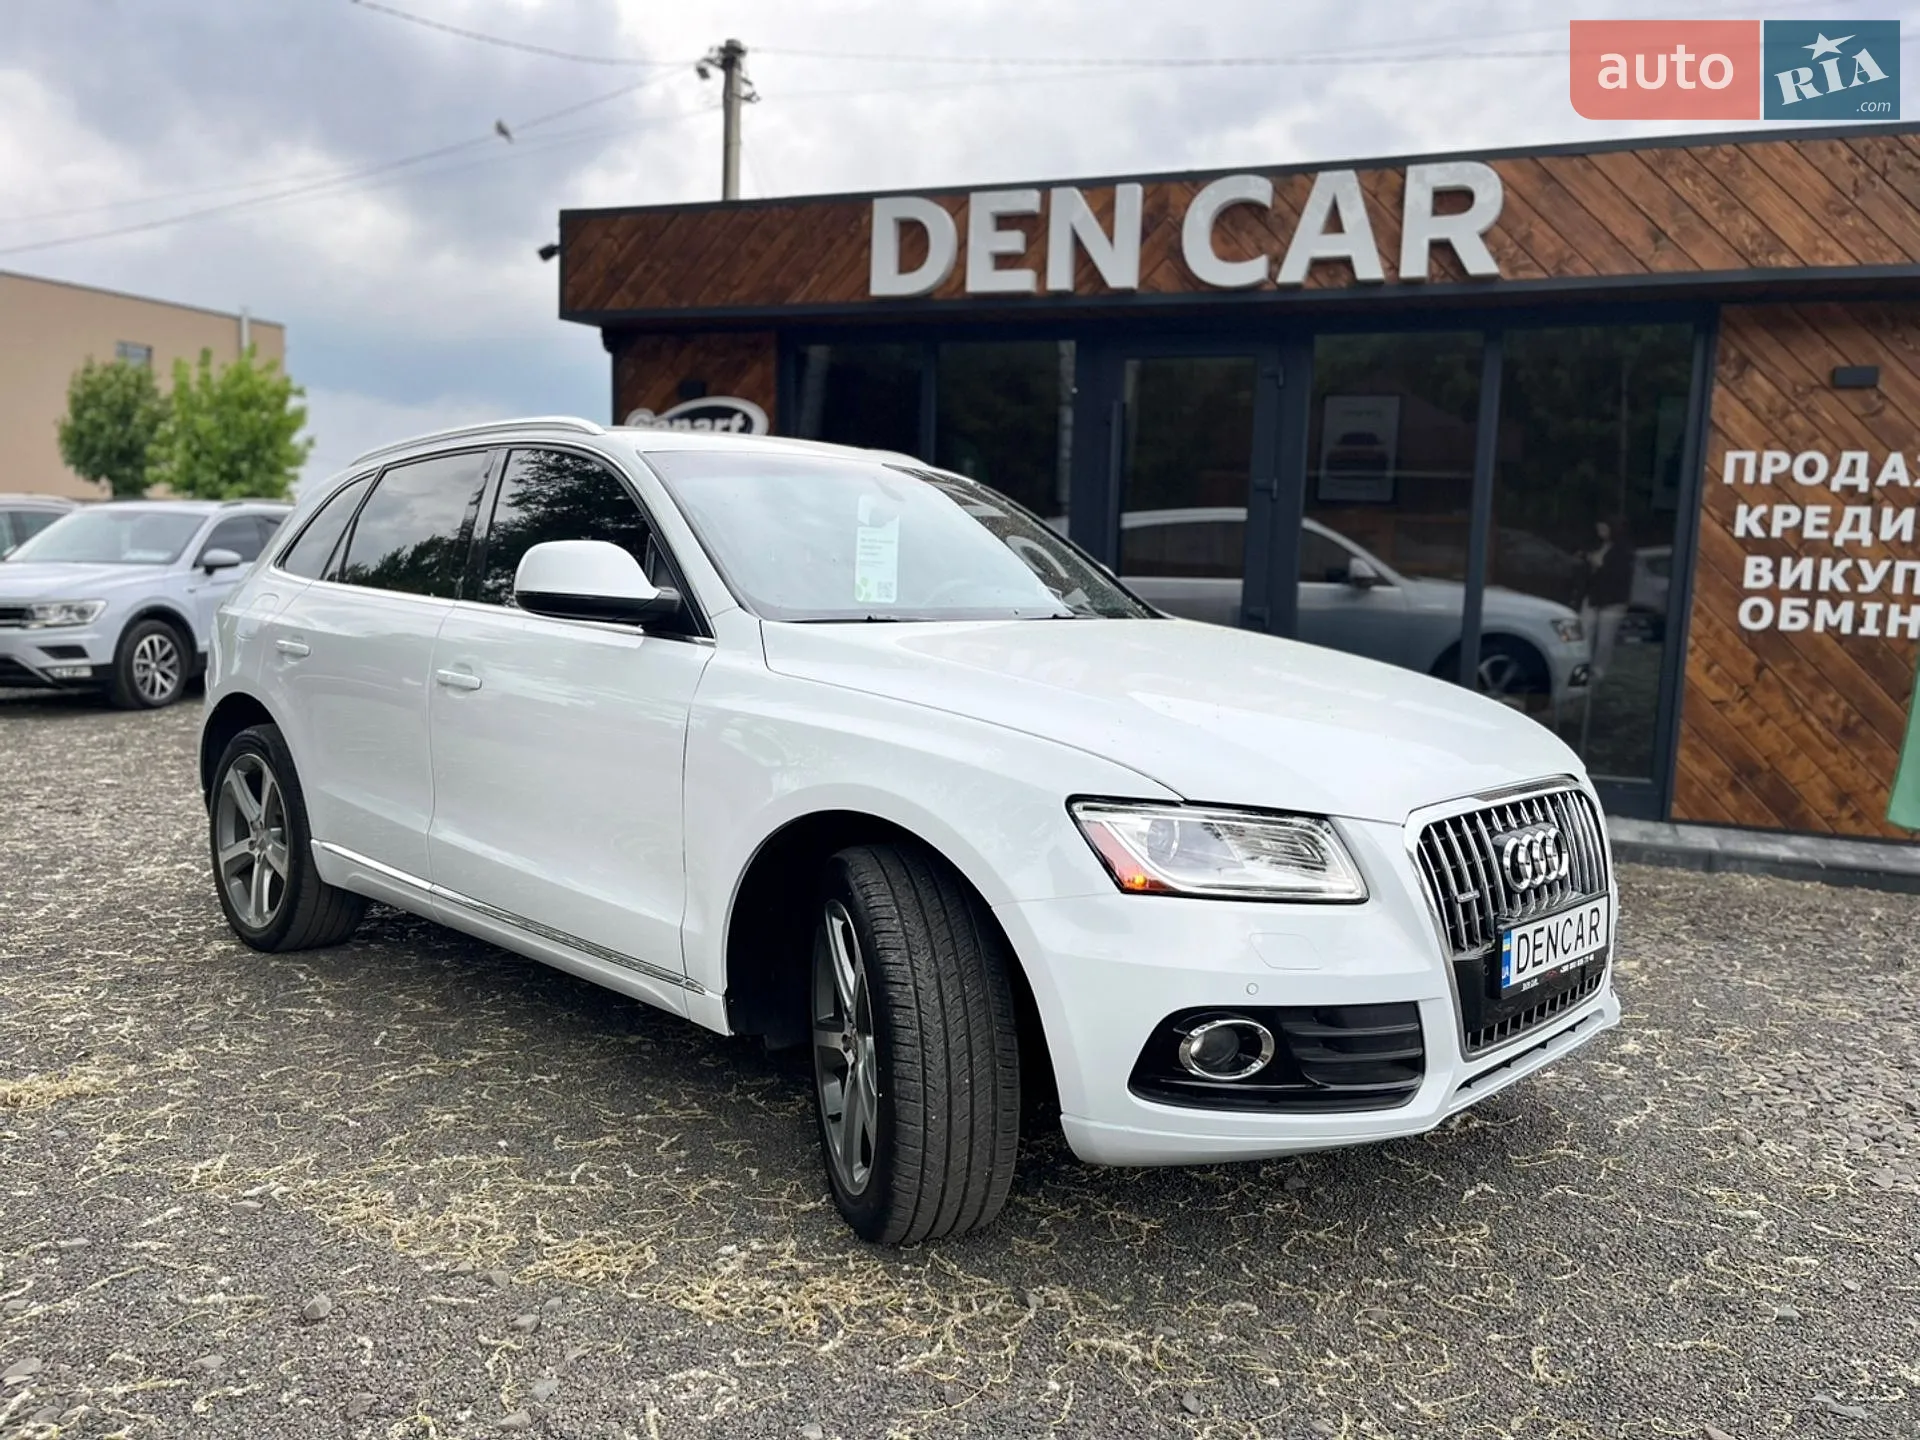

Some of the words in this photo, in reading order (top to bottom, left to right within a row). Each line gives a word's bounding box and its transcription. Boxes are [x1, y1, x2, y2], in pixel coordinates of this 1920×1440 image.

[869, 183, 1143, 297] DEN
[1181, 160, 1504, 288] CAR
[1723, 451, 1920, 492] ПРОДА
[1743, 555, 1920, 595] ВИКУП
[1738, 597, 1920, 639] ОБМІН
[1517, 907, 1601, 975] DENCAR
